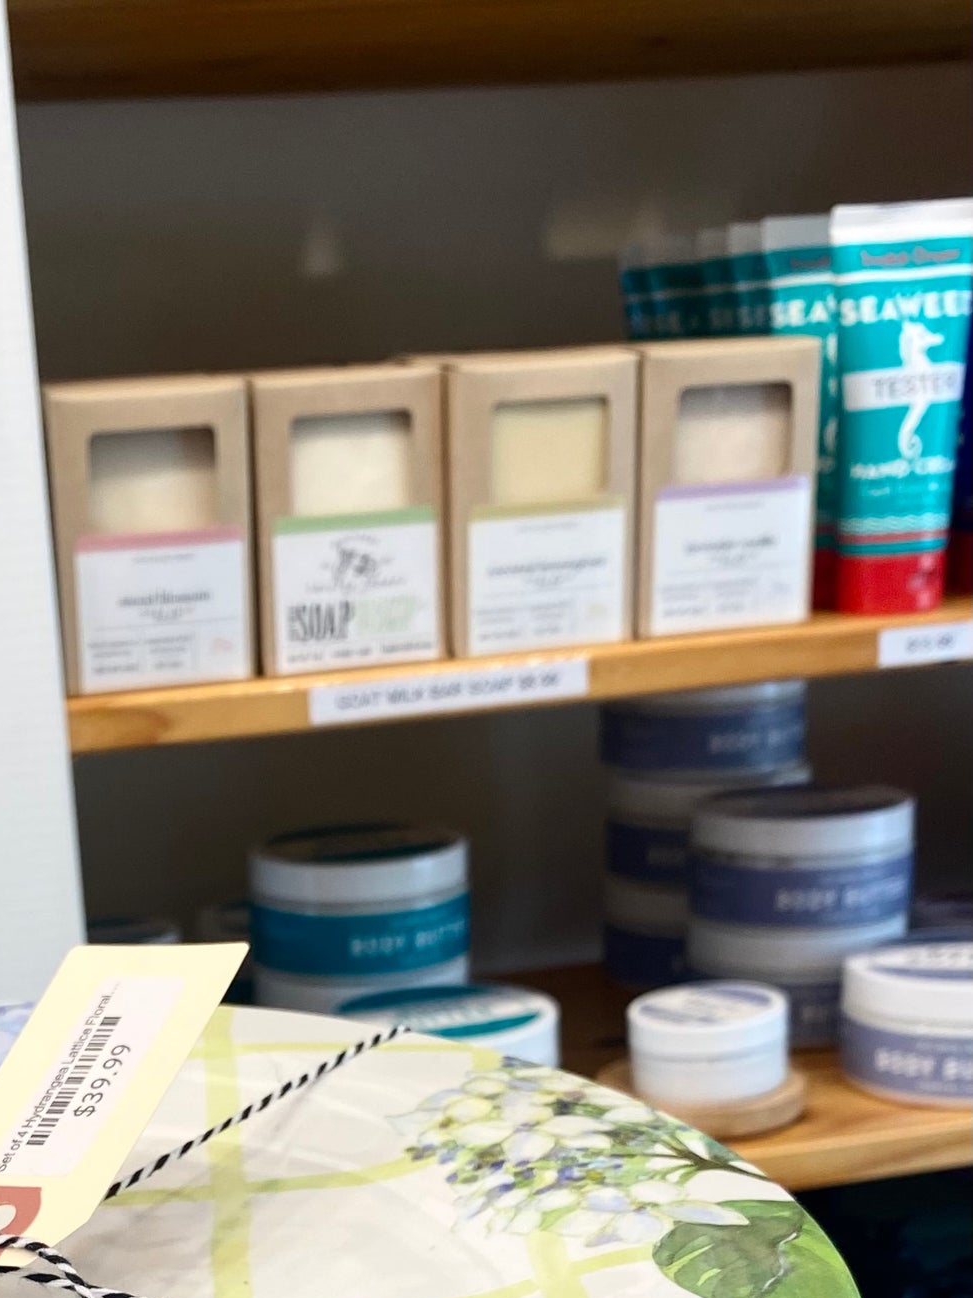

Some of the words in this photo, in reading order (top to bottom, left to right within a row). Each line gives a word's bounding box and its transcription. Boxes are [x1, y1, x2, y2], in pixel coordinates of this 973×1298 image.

[294, 599, 355, 642] SOAP
[429, 681, 463, 701] BAR
[468, 676, 514, 697] SOAP
[10, 1138, 23, 1152] of
[21, 1066, 70, 1128] Hydrangea
[61, 1028, 93, 1065] Lattice
[73, 1044, 132, 1118] $39.99
